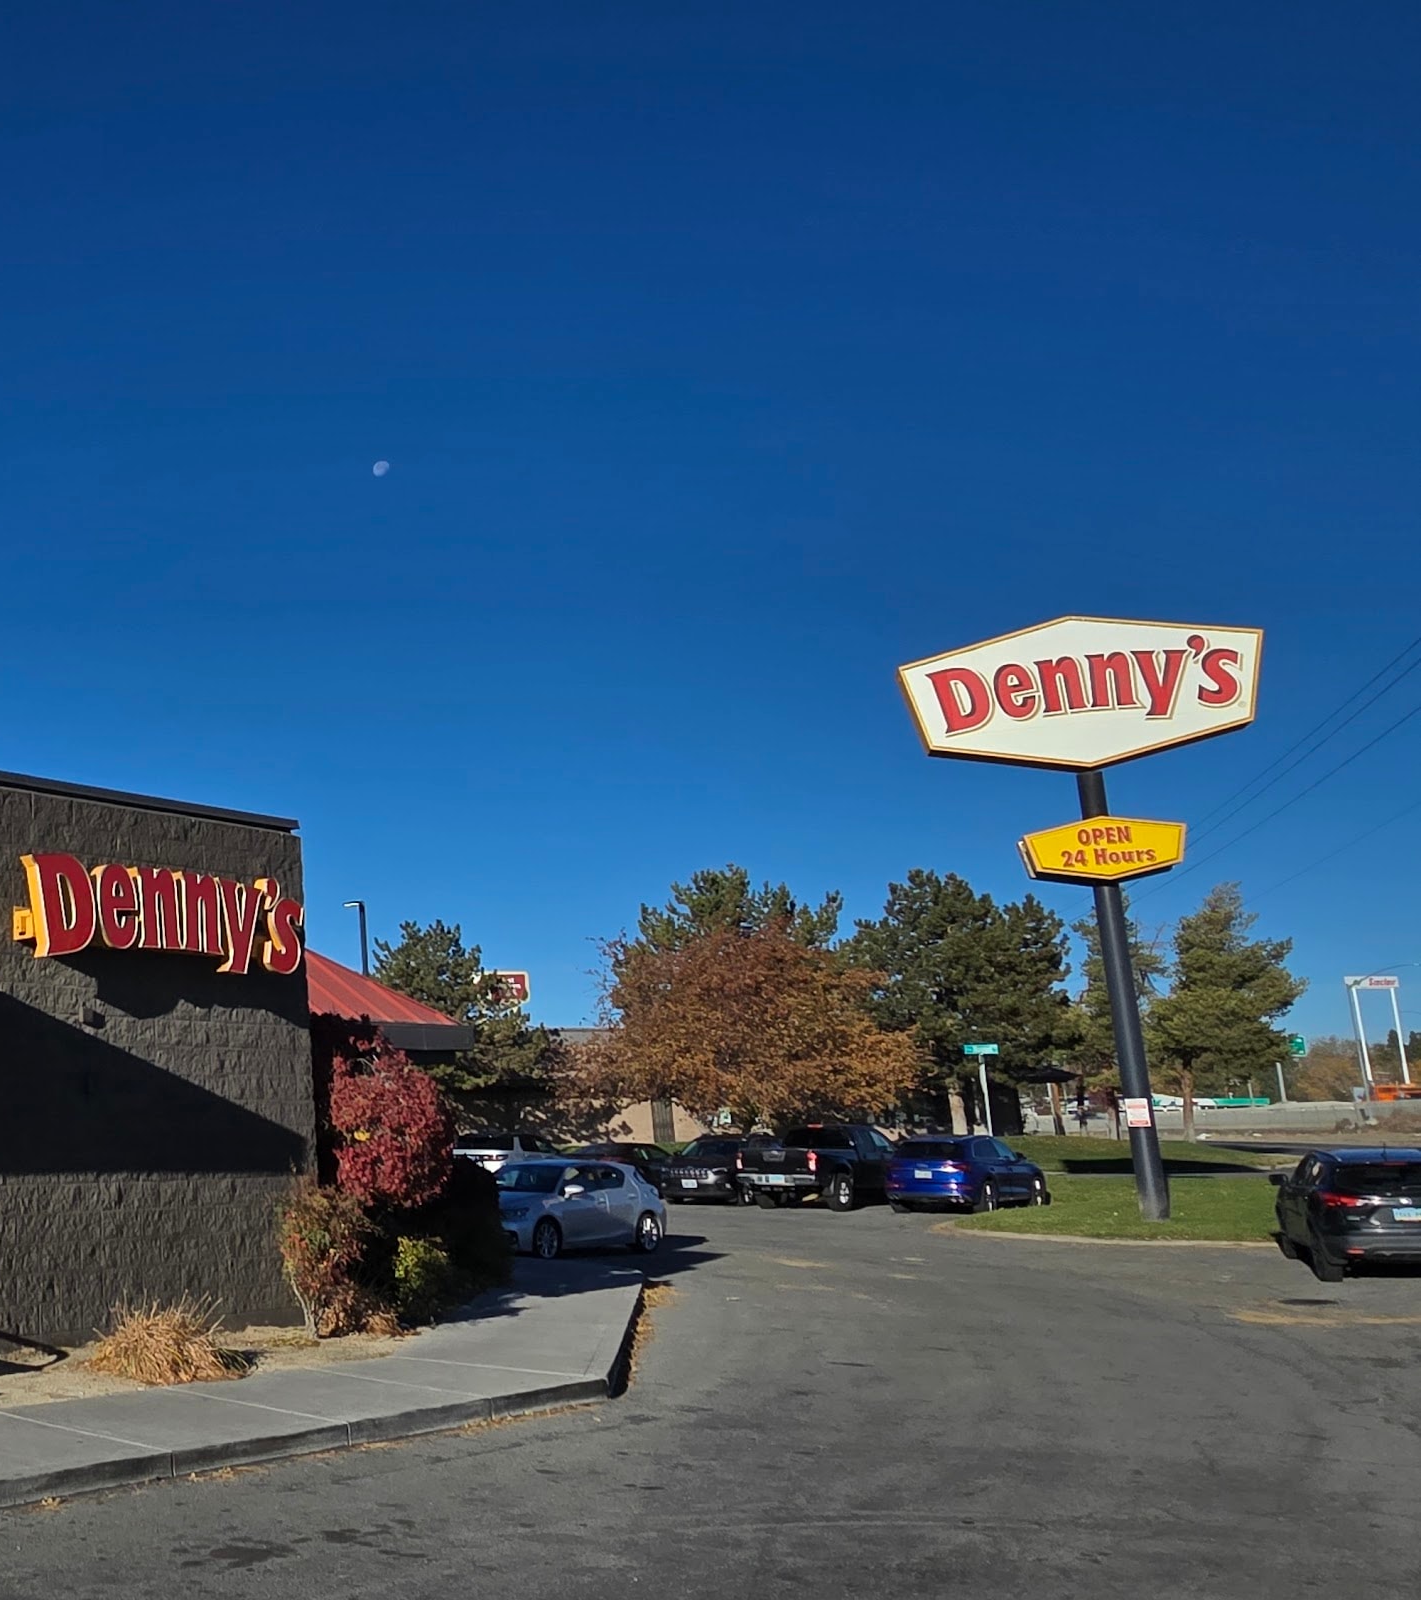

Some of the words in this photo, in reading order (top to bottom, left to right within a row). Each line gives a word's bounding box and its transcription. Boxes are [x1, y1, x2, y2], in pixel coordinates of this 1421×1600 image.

[925, 634, 1243, 736] Denny's
[1061, 850, 1088, 868] 24
[1094, 848, 1157, 866] Hours
[1077, 825, 1133, 846] OPEN
[20, 853, 304, 975] Denny's
